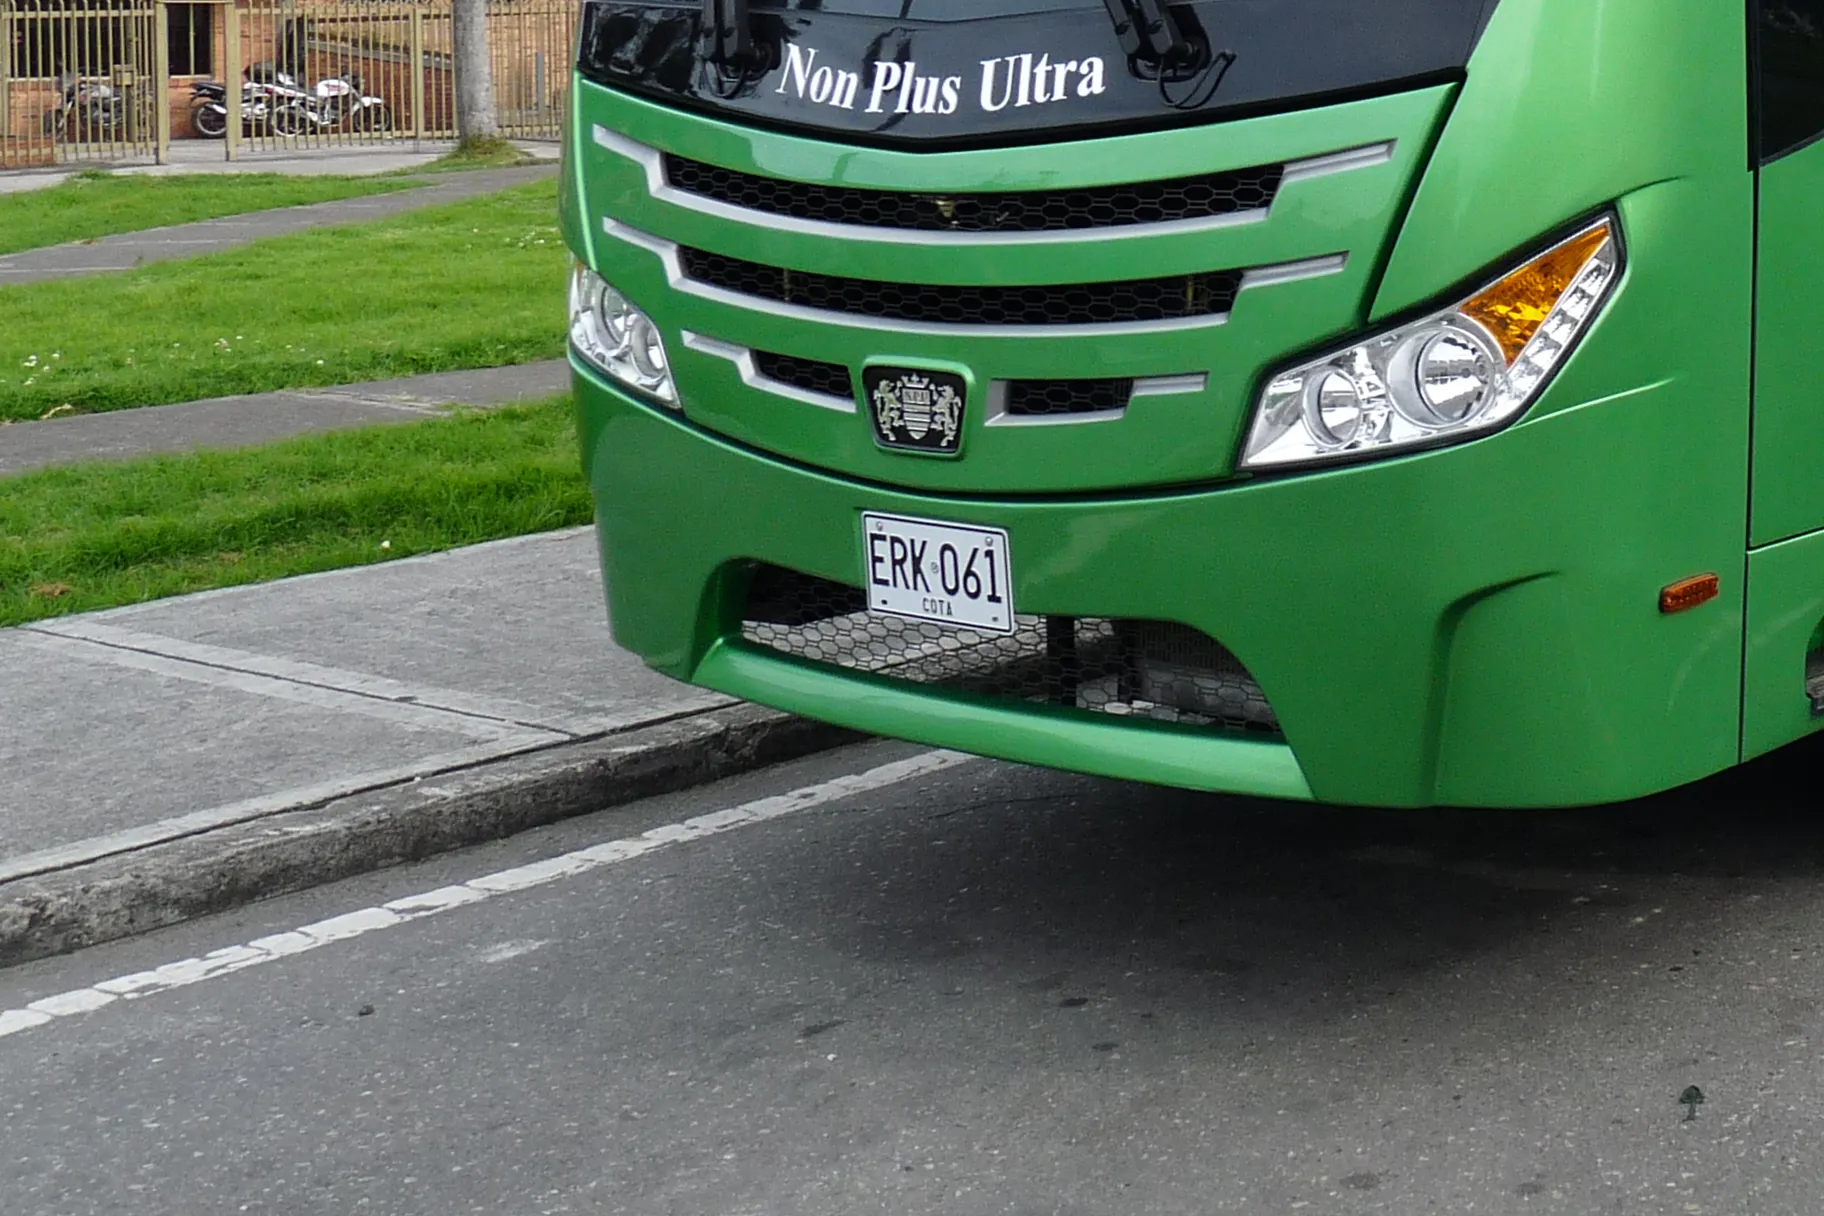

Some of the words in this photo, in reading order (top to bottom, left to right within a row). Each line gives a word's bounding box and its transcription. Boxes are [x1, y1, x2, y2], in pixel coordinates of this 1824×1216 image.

[775, 42, 859, 110] Non
[864, 61, 961, 115] Plus
[979, 52, 1106, 112] Ultra
[869, 532, 931, 593] ERK
[939, 543, 1002, 603] 061
[922, 597, 953, 616] COTA
